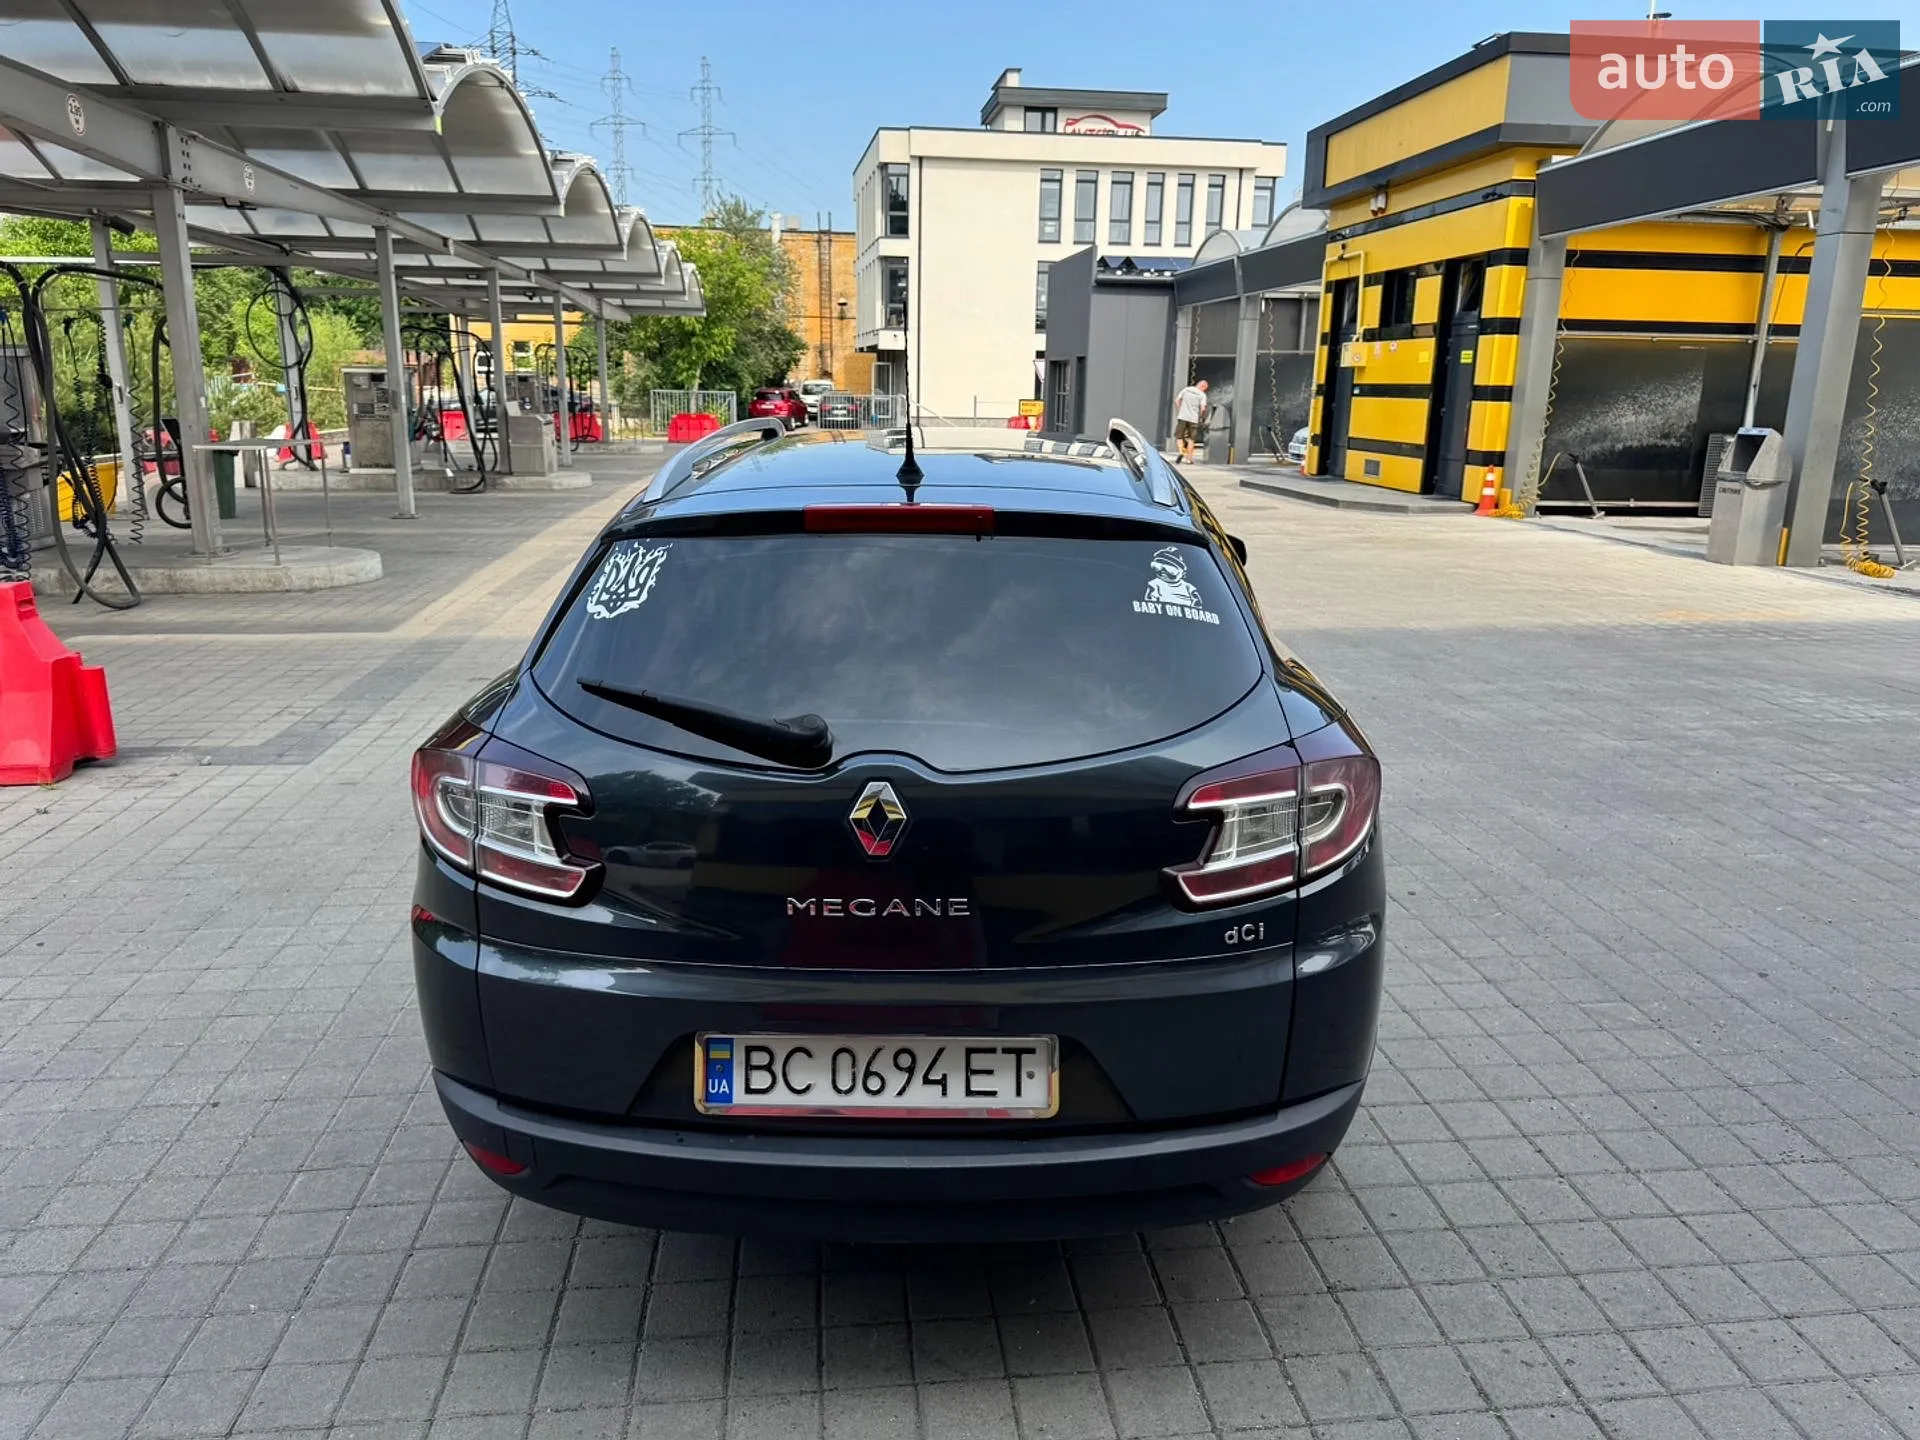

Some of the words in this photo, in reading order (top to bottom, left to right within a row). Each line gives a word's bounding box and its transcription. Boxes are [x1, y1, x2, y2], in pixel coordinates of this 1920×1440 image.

[1132, 600, 1162, 615] BABY
[1165, 603, 1183, 618] ON
[1184, 606, 1220, 625] BOARD
[786, 897, 971, 917] MEGANE
[1224, 922, 1265, 945] dCi
[743, 1045, 815, 1096] BC
[830, 1046, 949, 1097] 0694
[964, 1046, 1038, 1098] ET
[708, 1079, 731, 1095] UA
